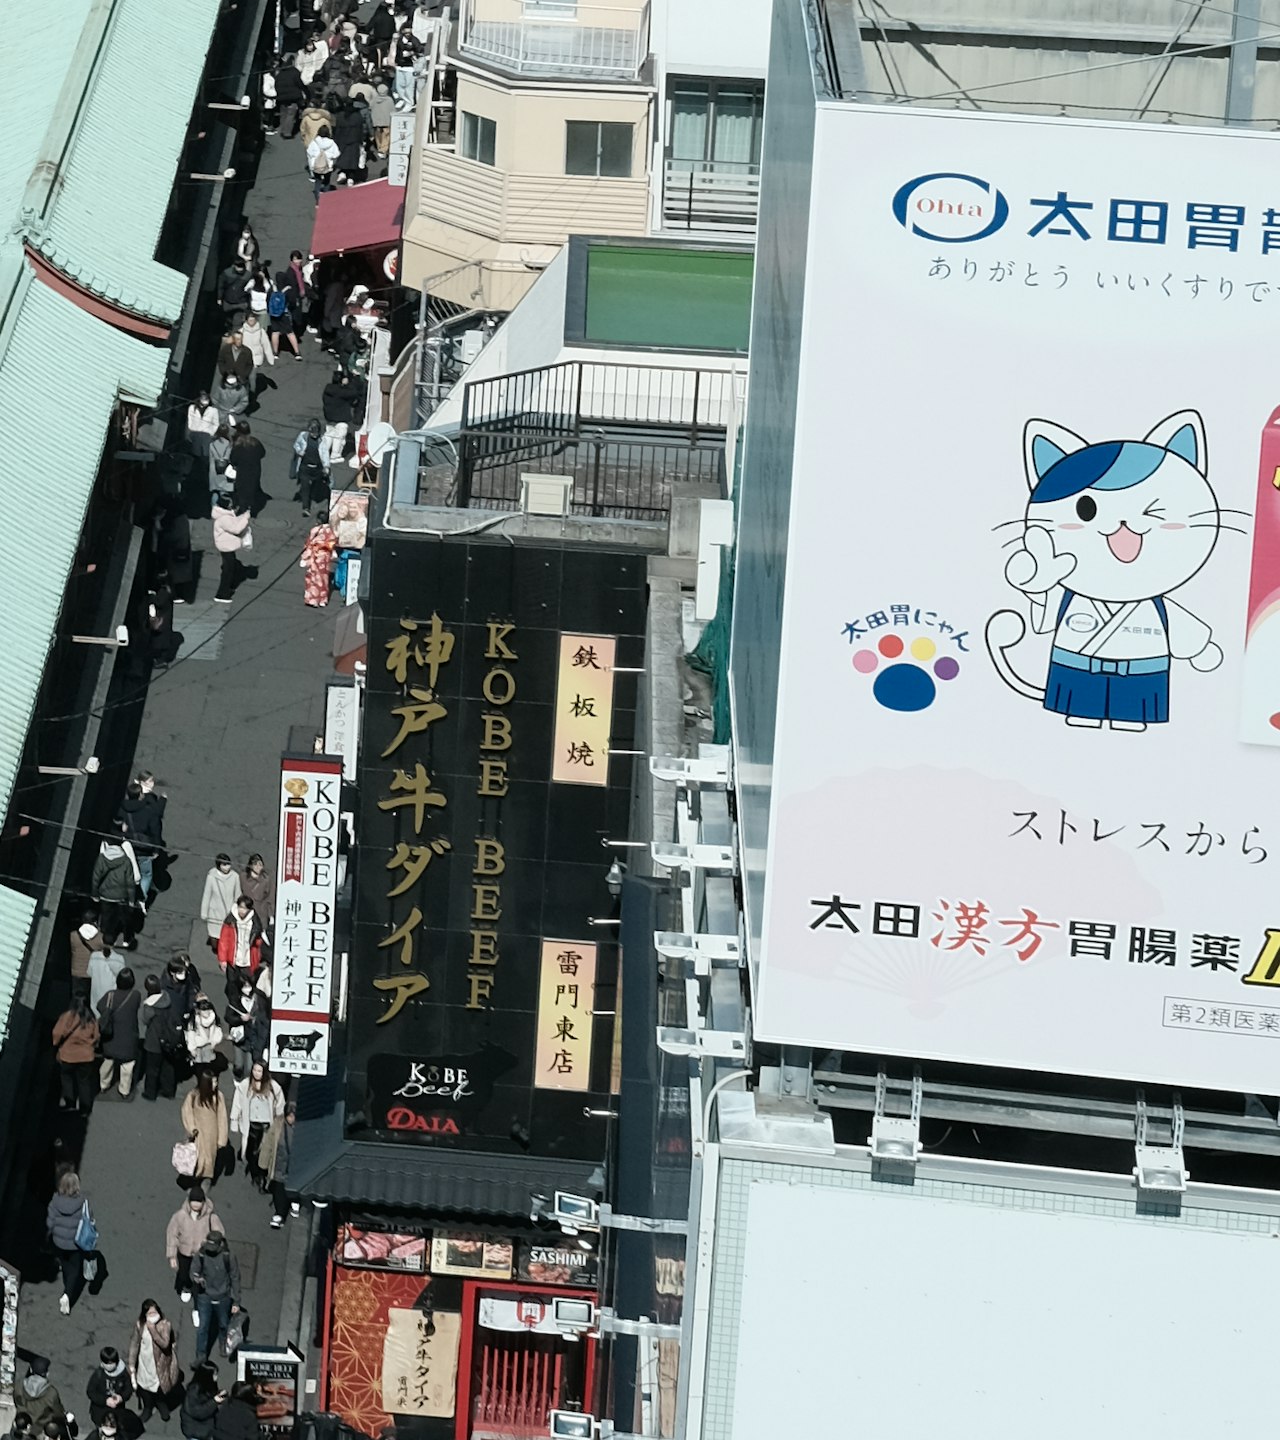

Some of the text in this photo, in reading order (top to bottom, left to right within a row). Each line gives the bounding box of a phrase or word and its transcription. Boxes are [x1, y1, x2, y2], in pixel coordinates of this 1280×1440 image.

[917, 197, 983, 217] Ohta
[928, 256, 1280, 303] ありがとう いいくすりで
[840, 604, 970, 652] 太田胃にゃん
[567, 645, 602, 767] 鉄板焼
[372, 611, 455, 1024] 神戸牛ダイア
[466, 622, 518, 1010] KOBE BEEF
[1008, 809, 1268, 864] ストレスから
[305, 780, 334, 1006] KOBE BEEF
[281, 899, 302, 1006] 神戸牛ダイア
[547, 950, 583, 1075] 雷門東店
[392, 1080, 474, 1101] Beef
[409, 1062, 467, 1084] KOBE
[530, 1250, 586, 1267] SASHIMI
